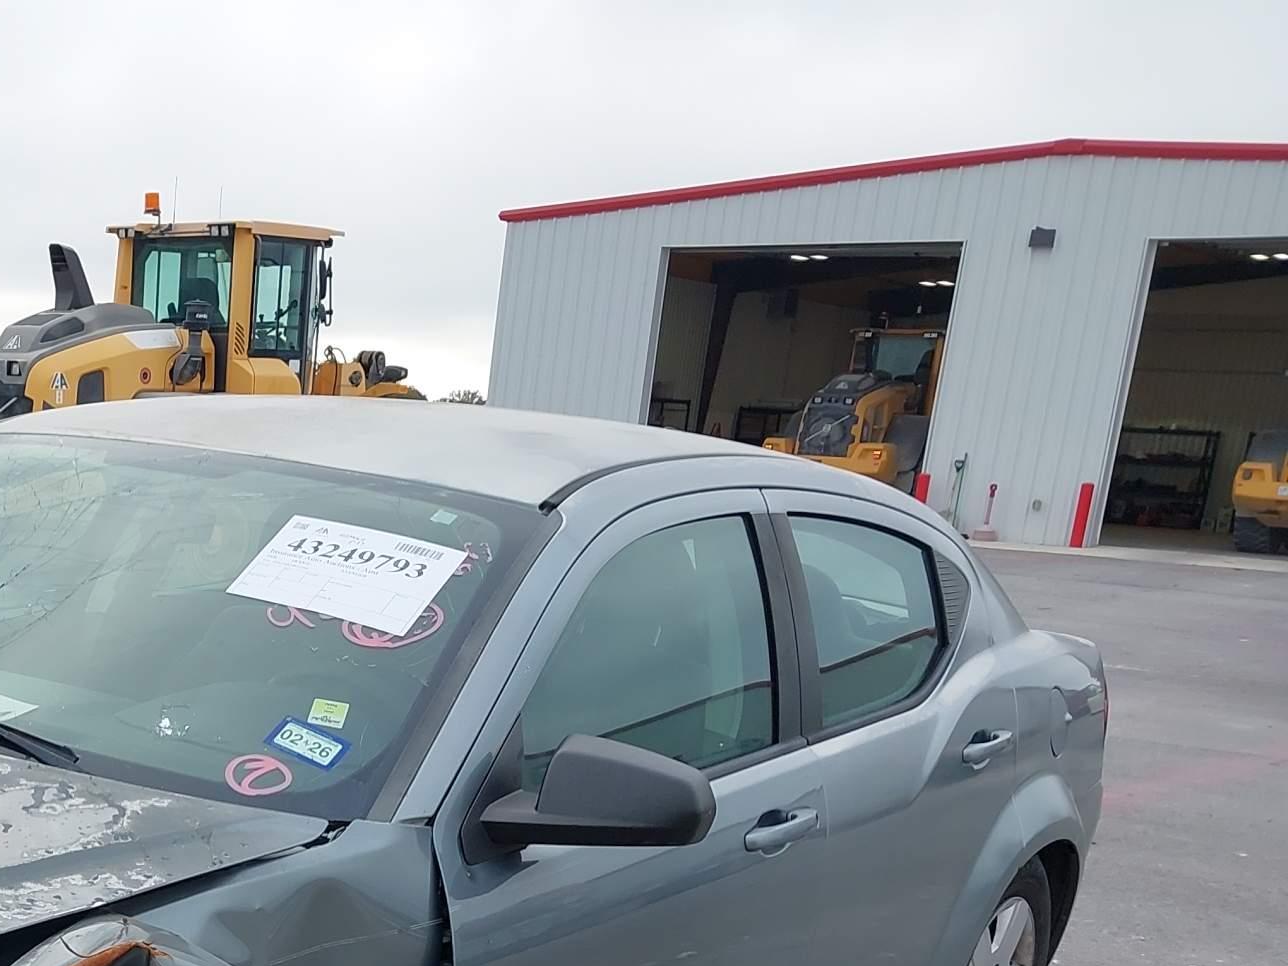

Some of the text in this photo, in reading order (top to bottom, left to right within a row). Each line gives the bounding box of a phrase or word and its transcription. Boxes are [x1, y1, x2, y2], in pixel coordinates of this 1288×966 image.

[287, 537, 428, 579] 43249793
[280, 729, 304, 746] 02
[307, 741, 333, 758] 26
